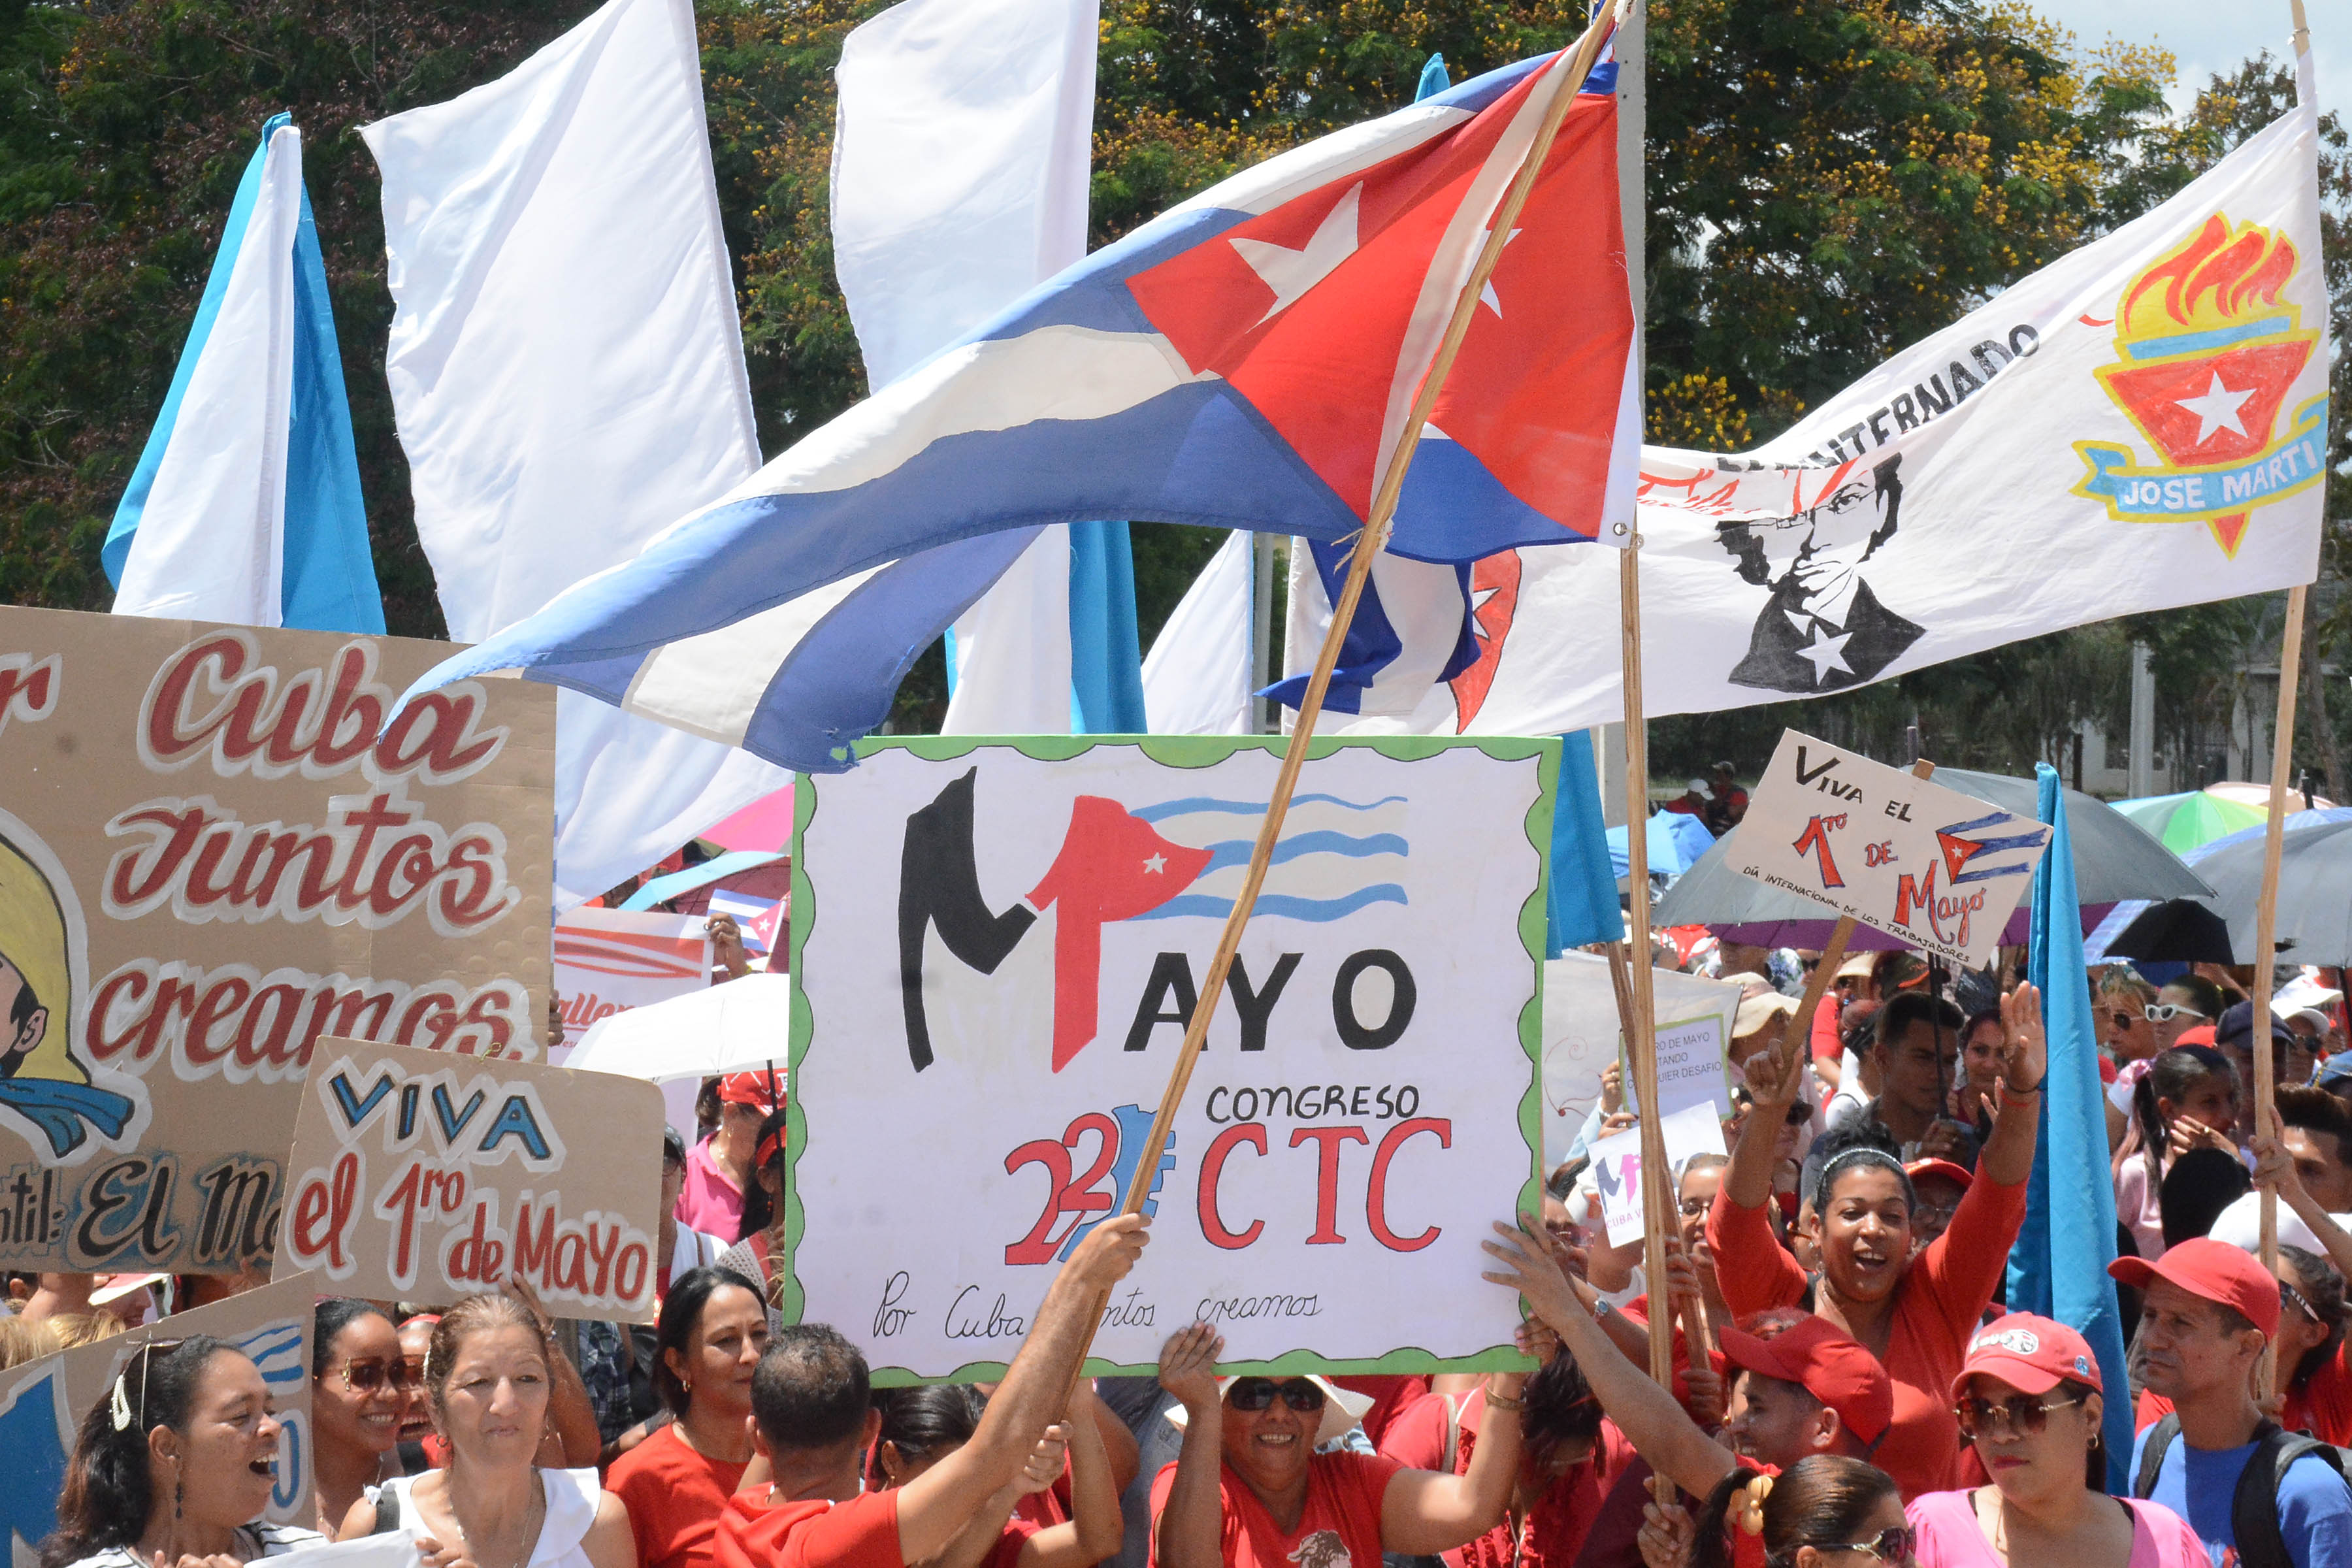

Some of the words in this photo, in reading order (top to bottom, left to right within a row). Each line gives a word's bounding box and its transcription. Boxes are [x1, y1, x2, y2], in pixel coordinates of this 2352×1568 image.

[2123, 477, 2206, 510] JOSE
[2222, 440, 2318, 502] MARTI
[149, 637, 503, 772] Cuba
[1884, 800, 1912, 823] EL
[111, 792, 508, 928] Juntos
[1865, 840, 1899, 868] DE
[1893, 859, 1987, 947] Mayo
[1844, 905, 1858, 915] DE
[1862, 913, 1879, 926] LOS
[86, 969, 523, 1068] creamos
[1668, 1036, 1682, 1049] DE
[1683, 1031, 1710, 1046] MAYO
[1681, 1060, 1723, 1078] DESAFIO
[329, 1071, 553, 1161] VIVA
[77, 1159, 175, 1258] El
[294, 1151, 358, 1268] el
[384, 1162, 466, 1278] 1ro
[448, 1201, 503, 1284] de
[1197, 1117, 1452, 1253] CTC
[1605, 1214, 1633, 1230] CUBA
[872, 1270, 917, 1339] Por
[944, 1284, 1025, 1339] Cuba
[1100, 1286, 1156, 1328] ntos
[1196, 1293, 1323, 1323] creamos
